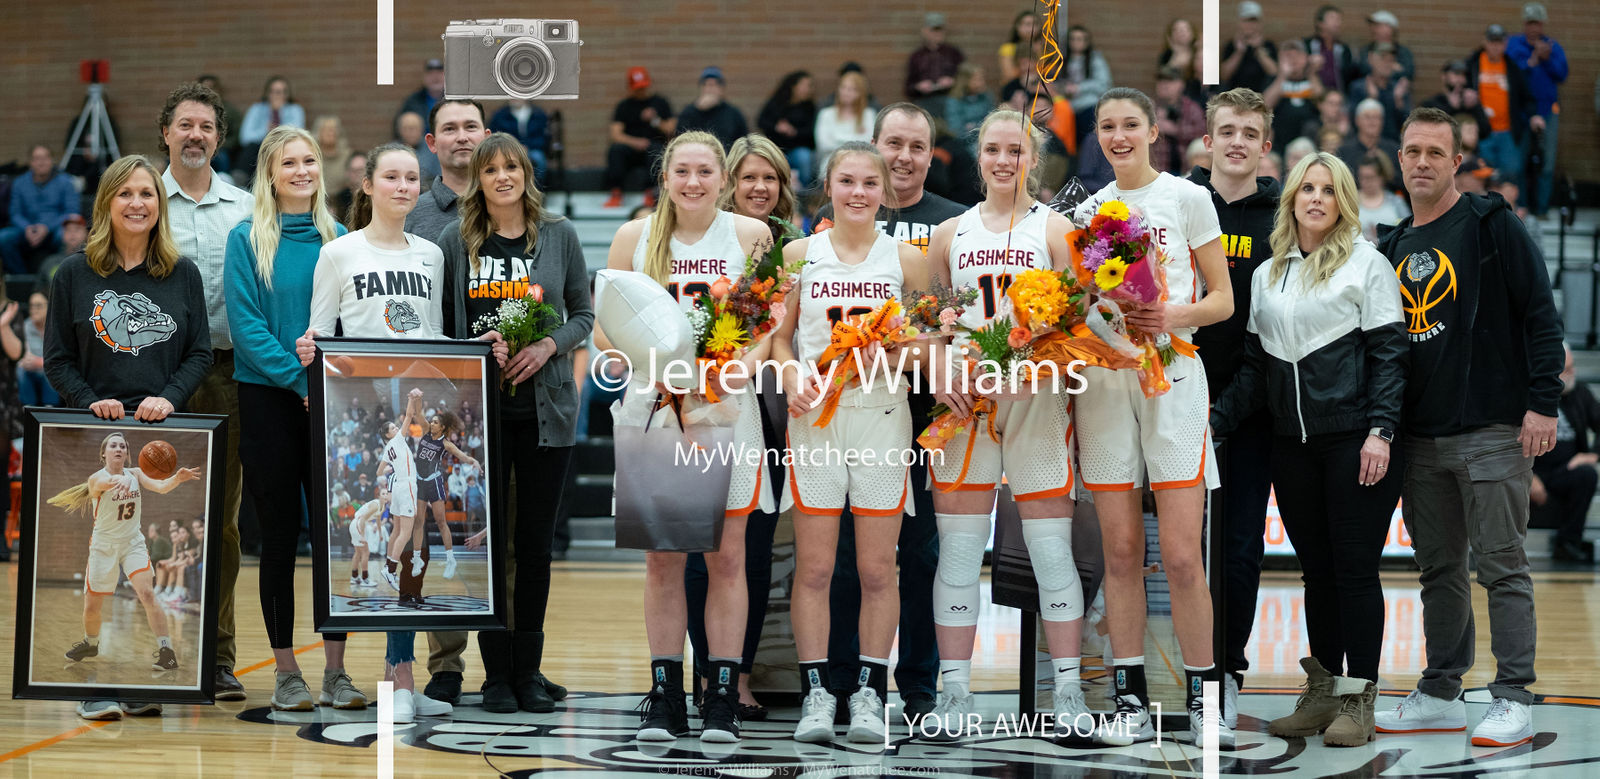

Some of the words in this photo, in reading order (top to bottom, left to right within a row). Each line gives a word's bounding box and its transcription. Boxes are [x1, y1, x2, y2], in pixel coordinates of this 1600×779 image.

[468, 255, 506, 281] WE
[671, 259, 728, 276] SHMERE
[958, 249, 1035, 270] CASHMERE
[468, 279, 530, 300] CASHM
[811, 282, 892, 300] CASHMERE
[1407, 321, 1446, 342] SHMERE
[117, 502, 136, 521] 13
